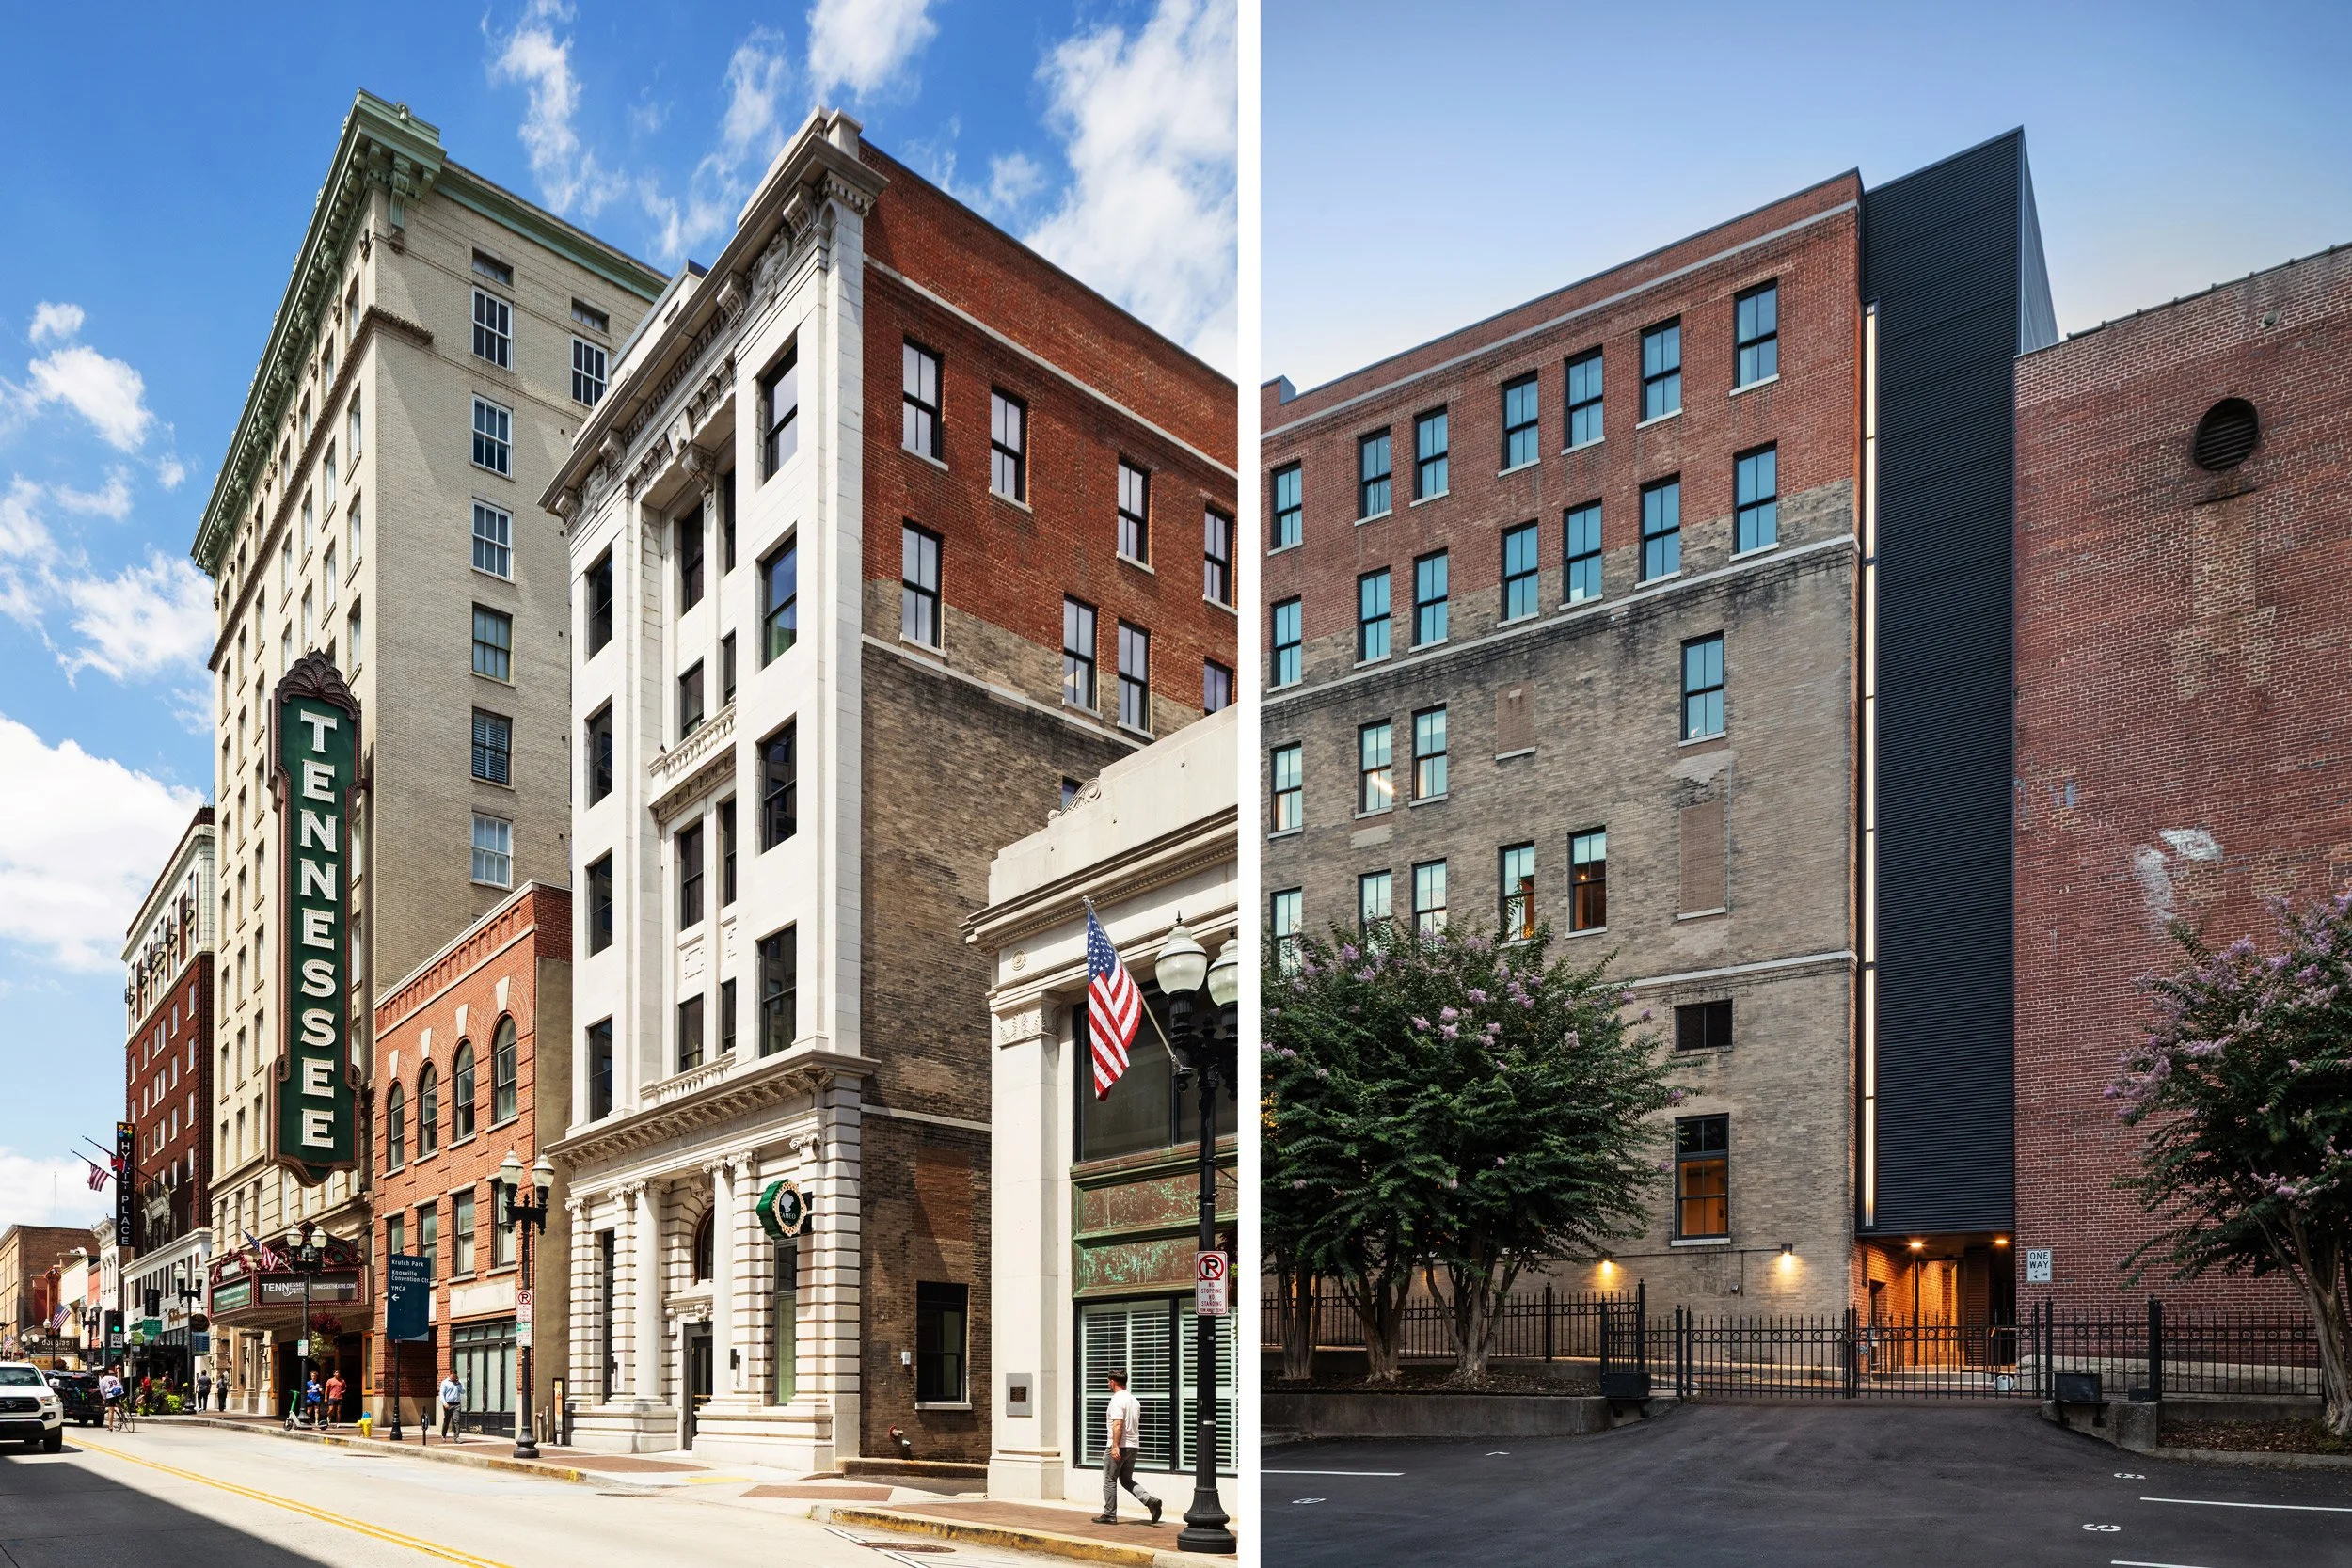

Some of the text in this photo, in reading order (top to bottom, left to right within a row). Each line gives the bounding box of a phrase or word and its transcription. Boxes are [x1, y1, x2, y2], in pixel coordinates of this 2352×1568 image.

[300, 708, 337, 1148] TENNESSEE
[121, 1196, 130, 1245] PLACE
[2029, 1252, 2049, 1260] ONE
[2029, 1260, 2049, 1269] WAY
[391, 1269, 417, 1277] Knoxville
